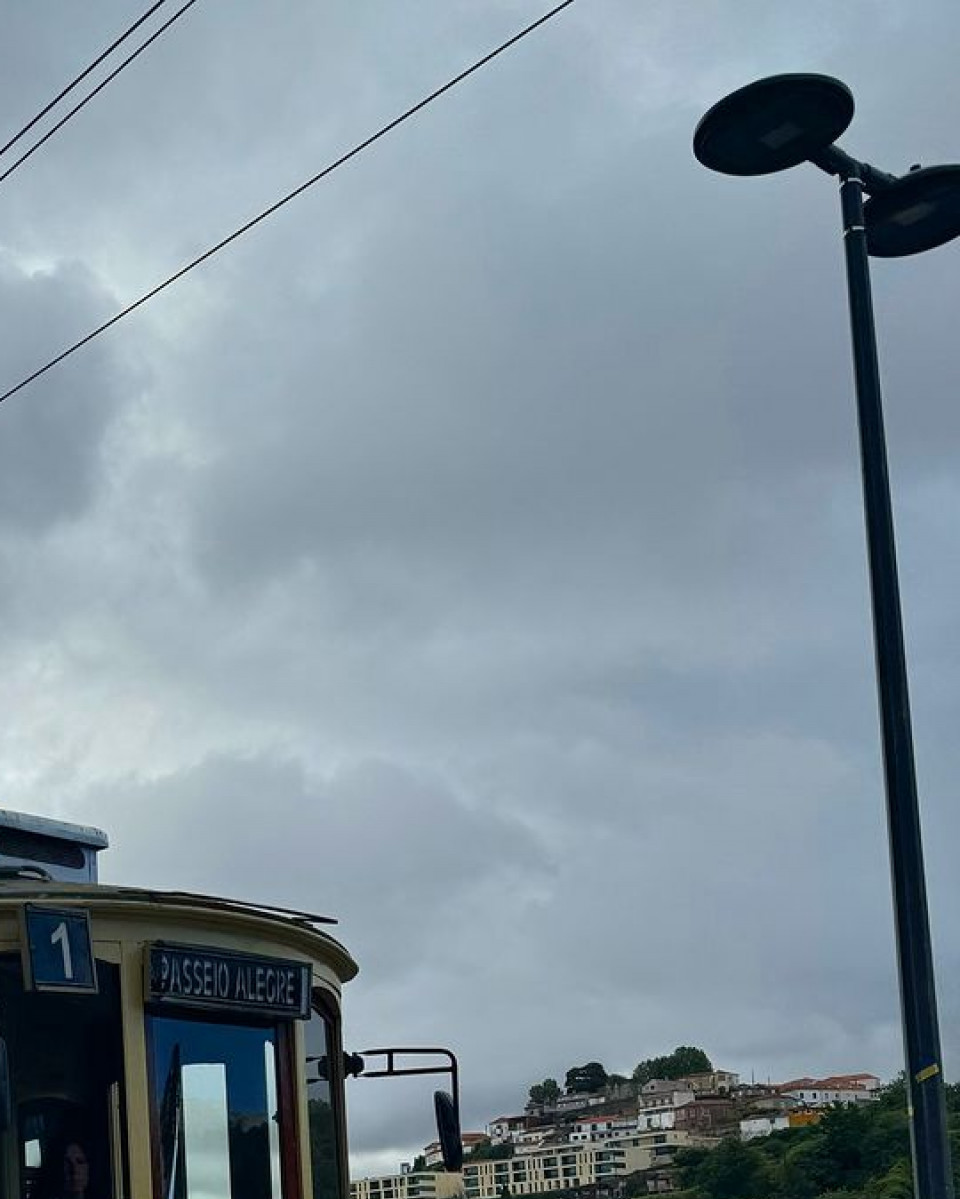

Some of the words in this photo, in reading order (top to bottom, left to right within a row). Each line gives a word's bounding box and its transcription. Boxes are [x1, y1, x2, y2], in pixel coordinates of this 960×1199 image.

[50, 921, 74, 979] 1
[159, 954, 229, 999] PASSEIO
[234, 965, 296, 1006] ALEGRE
